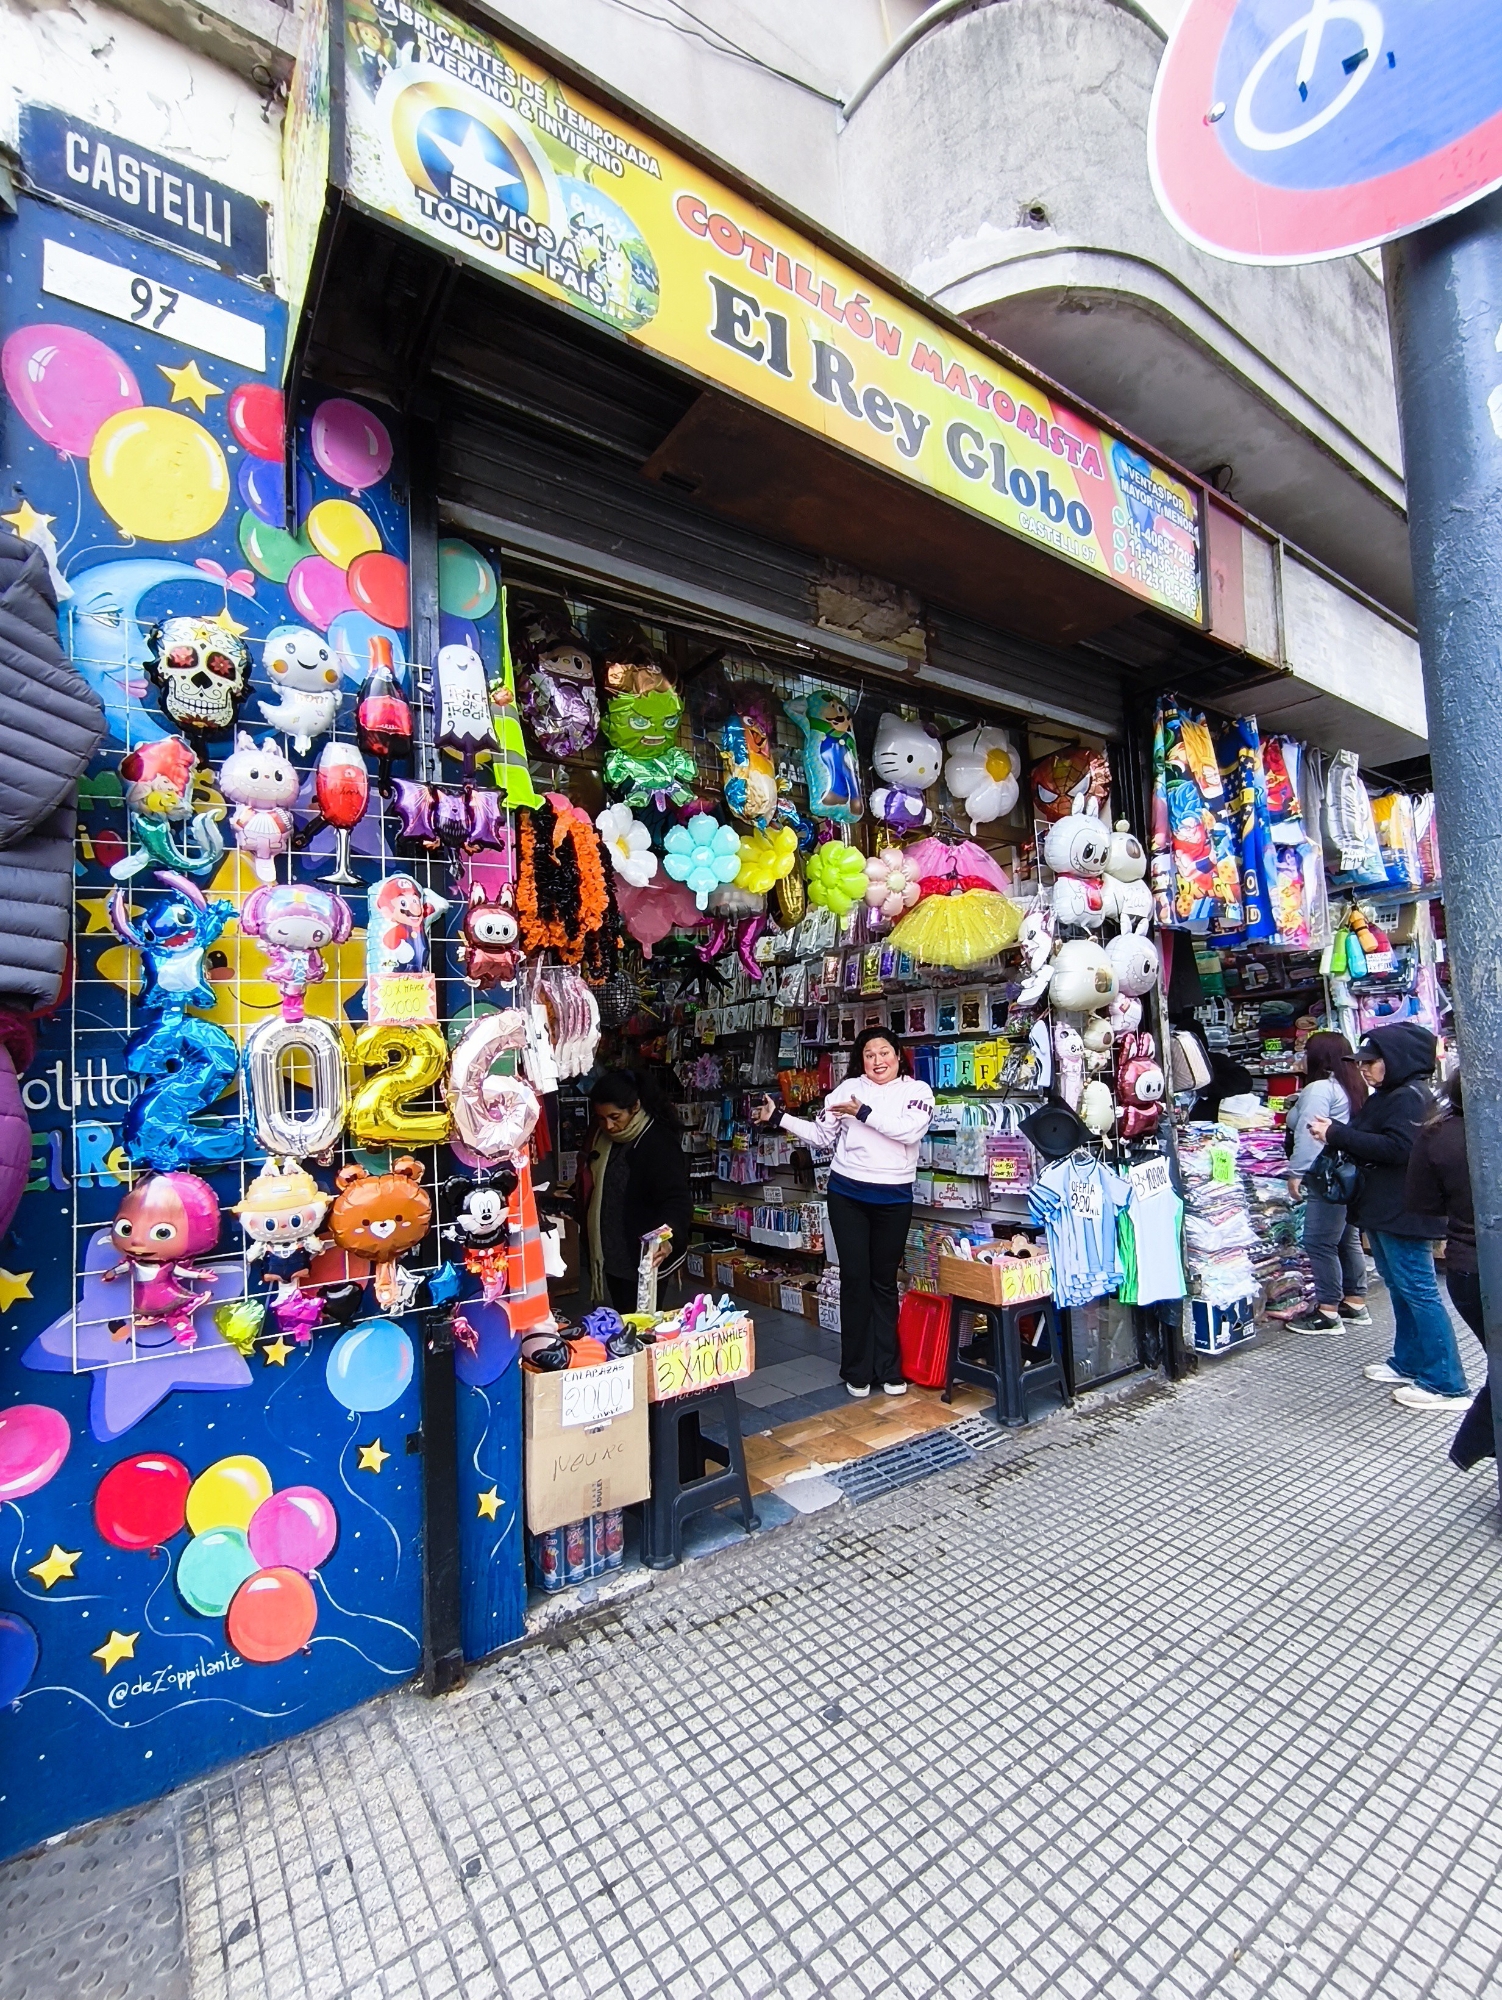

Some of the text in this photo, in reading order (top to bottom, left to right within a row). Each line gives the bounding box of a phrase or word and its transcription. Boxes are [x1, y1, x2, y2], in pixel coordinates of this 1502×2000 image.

[427, 45, 625, 178] VERANO & INVIERNO
[519, 76, 548, 107] DE
[555, 99, 663, 180] TEMPORADA
[66, 131, 232, 248] CASTELLI
[416, 189, 502, 250] TODO
[507, 236, 544, 272] EL
[450, 175, 582, 271] ENVIOS A
[130, 277, 180, 330] 97
[676, 194, 1104, 479] COTILLÓN MAYORISTA
[708, 275, 1094, 537] El Rey Globo
[1120, 477, 1195, 535] MAYOR Y MENOR
[1128, 467, 1186, 513] VENTAS POR
[1019, 512, 1097, 563] CASTELLI 97
[943, 1063, 951, 1078] F
[962, 1060, 971, 1075] F
[981, 1064, 989, 1079] F
[107, 1649, 245, 1710] @deZoppilante
